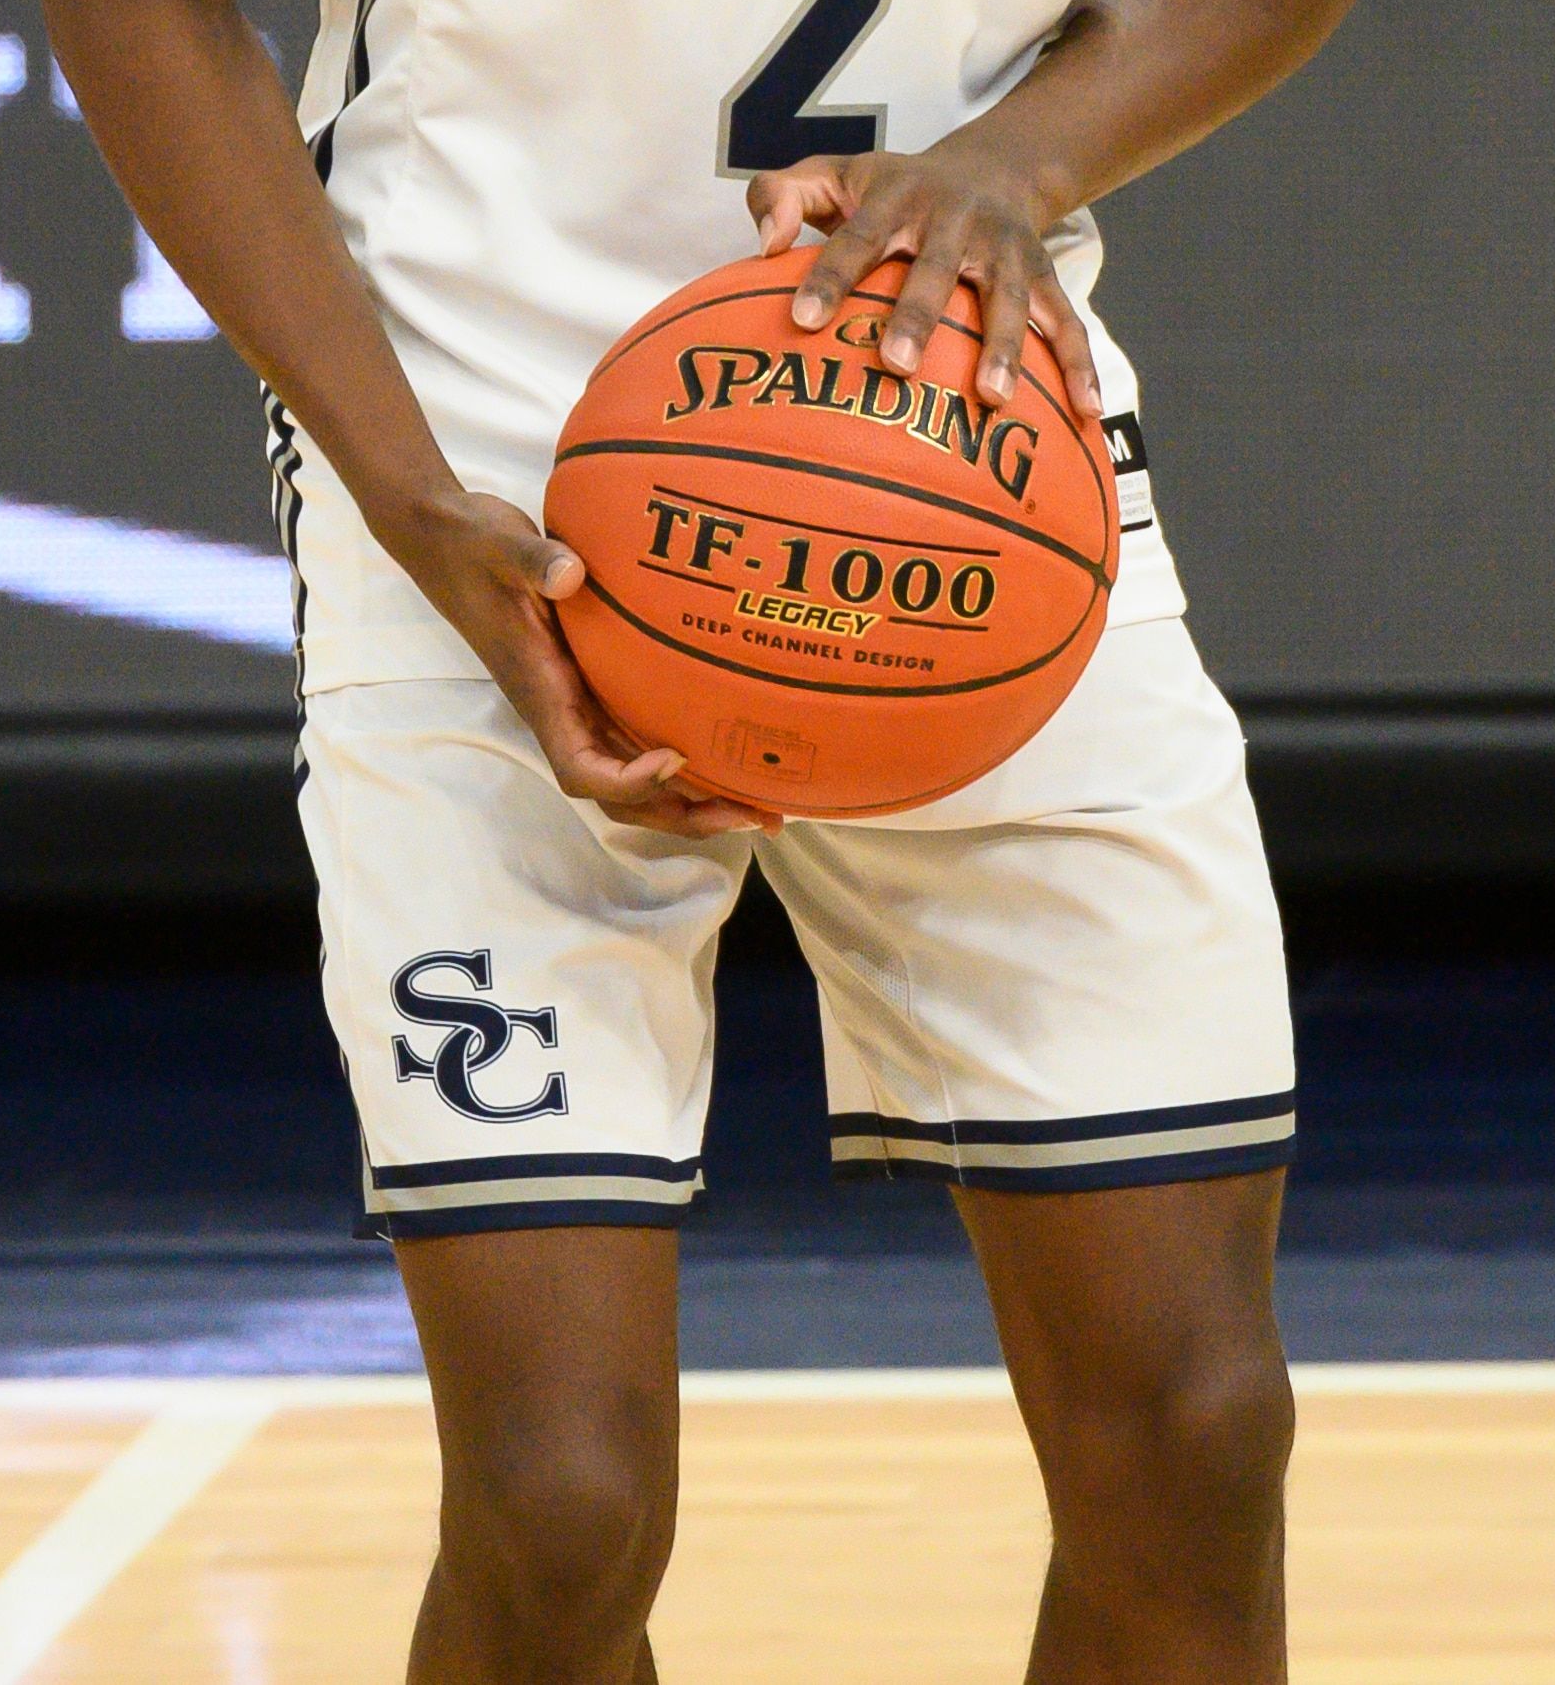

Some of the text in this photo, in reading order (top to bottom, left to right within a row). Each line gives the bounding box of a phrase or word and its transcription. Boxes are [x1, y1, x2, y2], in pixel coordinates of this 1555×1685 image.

[663, 345, 1039, 504] SPALDING
[644, 498, 997, 620] TF-1000
[735, 589, 882, 639] LEGACY
[682, 613, 936, 673] DEEP CHANNEL DESIGN
[390, 948, 569, 1124] SC
